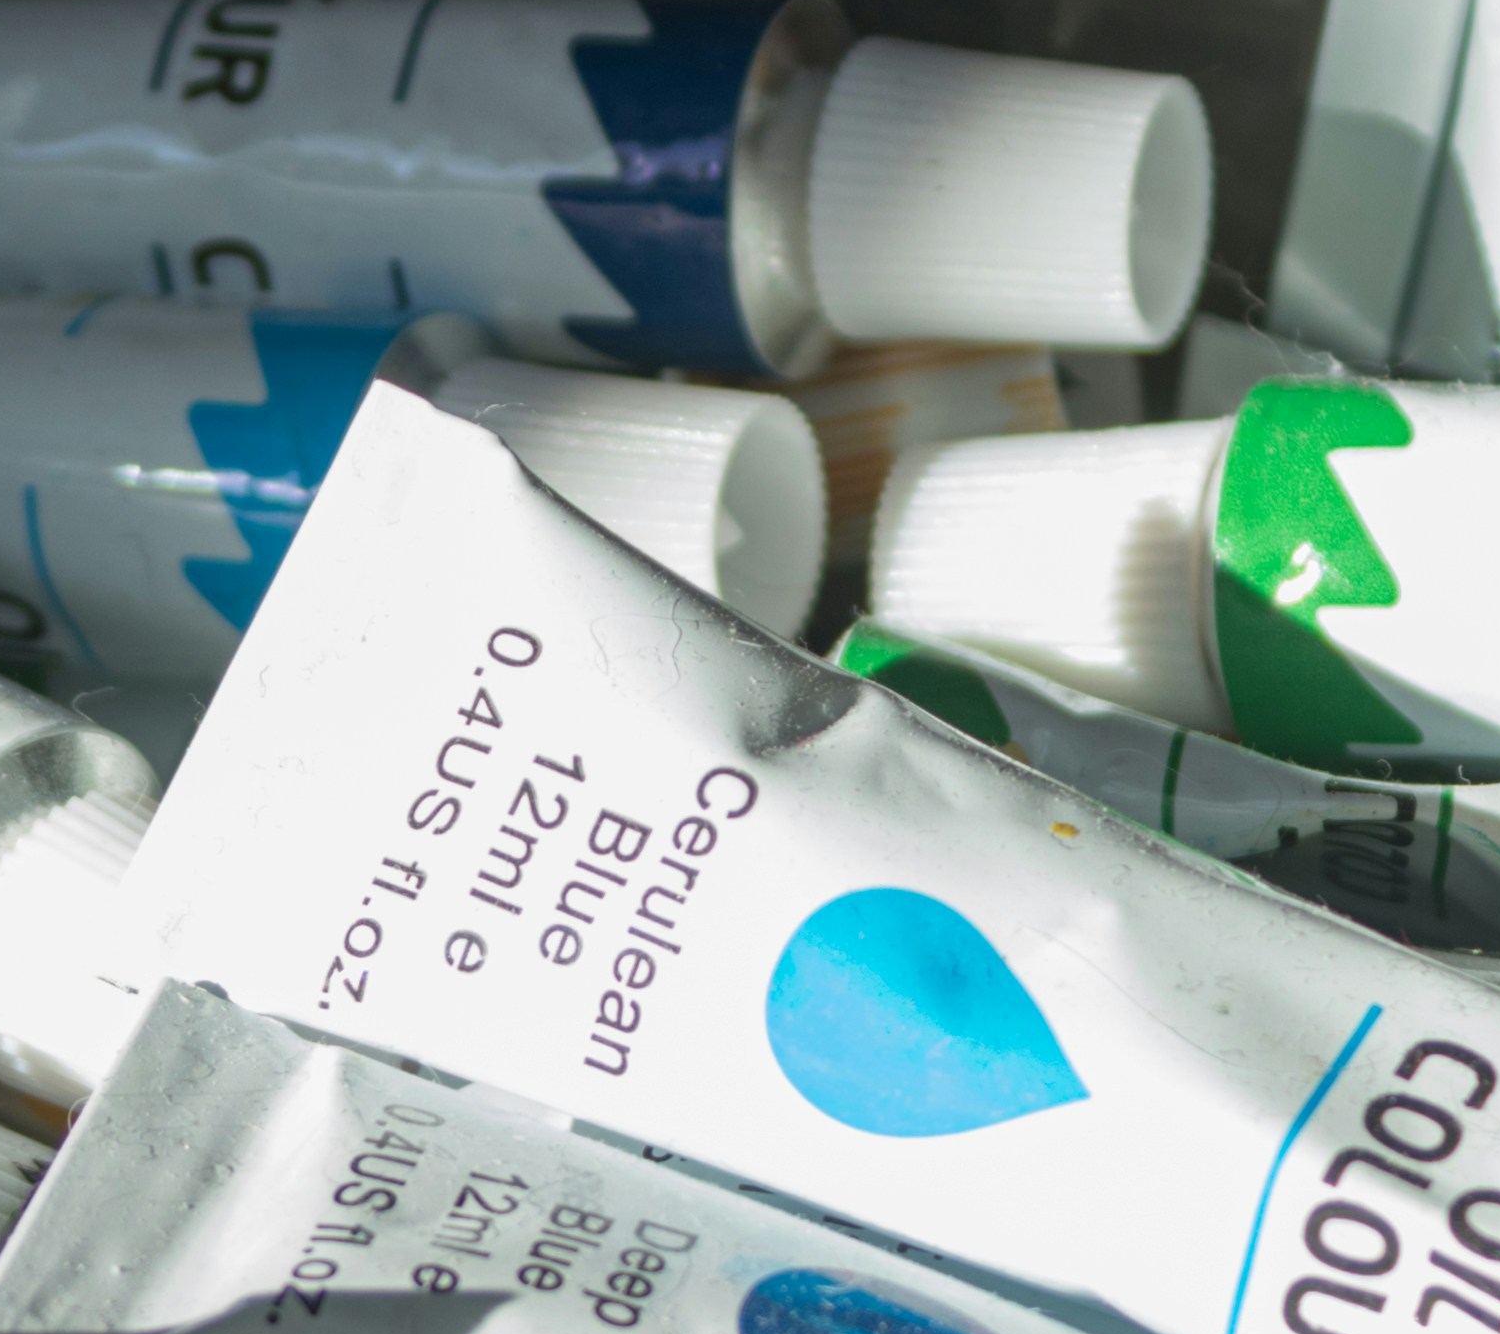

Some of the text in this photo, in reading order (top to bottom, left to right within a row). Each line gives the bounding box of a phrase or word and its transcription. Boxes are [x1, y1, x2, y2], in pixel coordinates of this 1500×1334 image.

[316, 624, 544, 1013] 0.4US fl.oz.
[443, 750, 588, 976] 12ml e
[538, 805, 655, 970] Blue
[582, 763, 760, 1080] Cerulean
[265, 1100, 447, 1327] 0.4US fl.oz.
[411, 1169, 530, 1298] 12ml e
[517, 1200, 615, 1294] Blue
[583, 1218, 699, 1331] Deep
